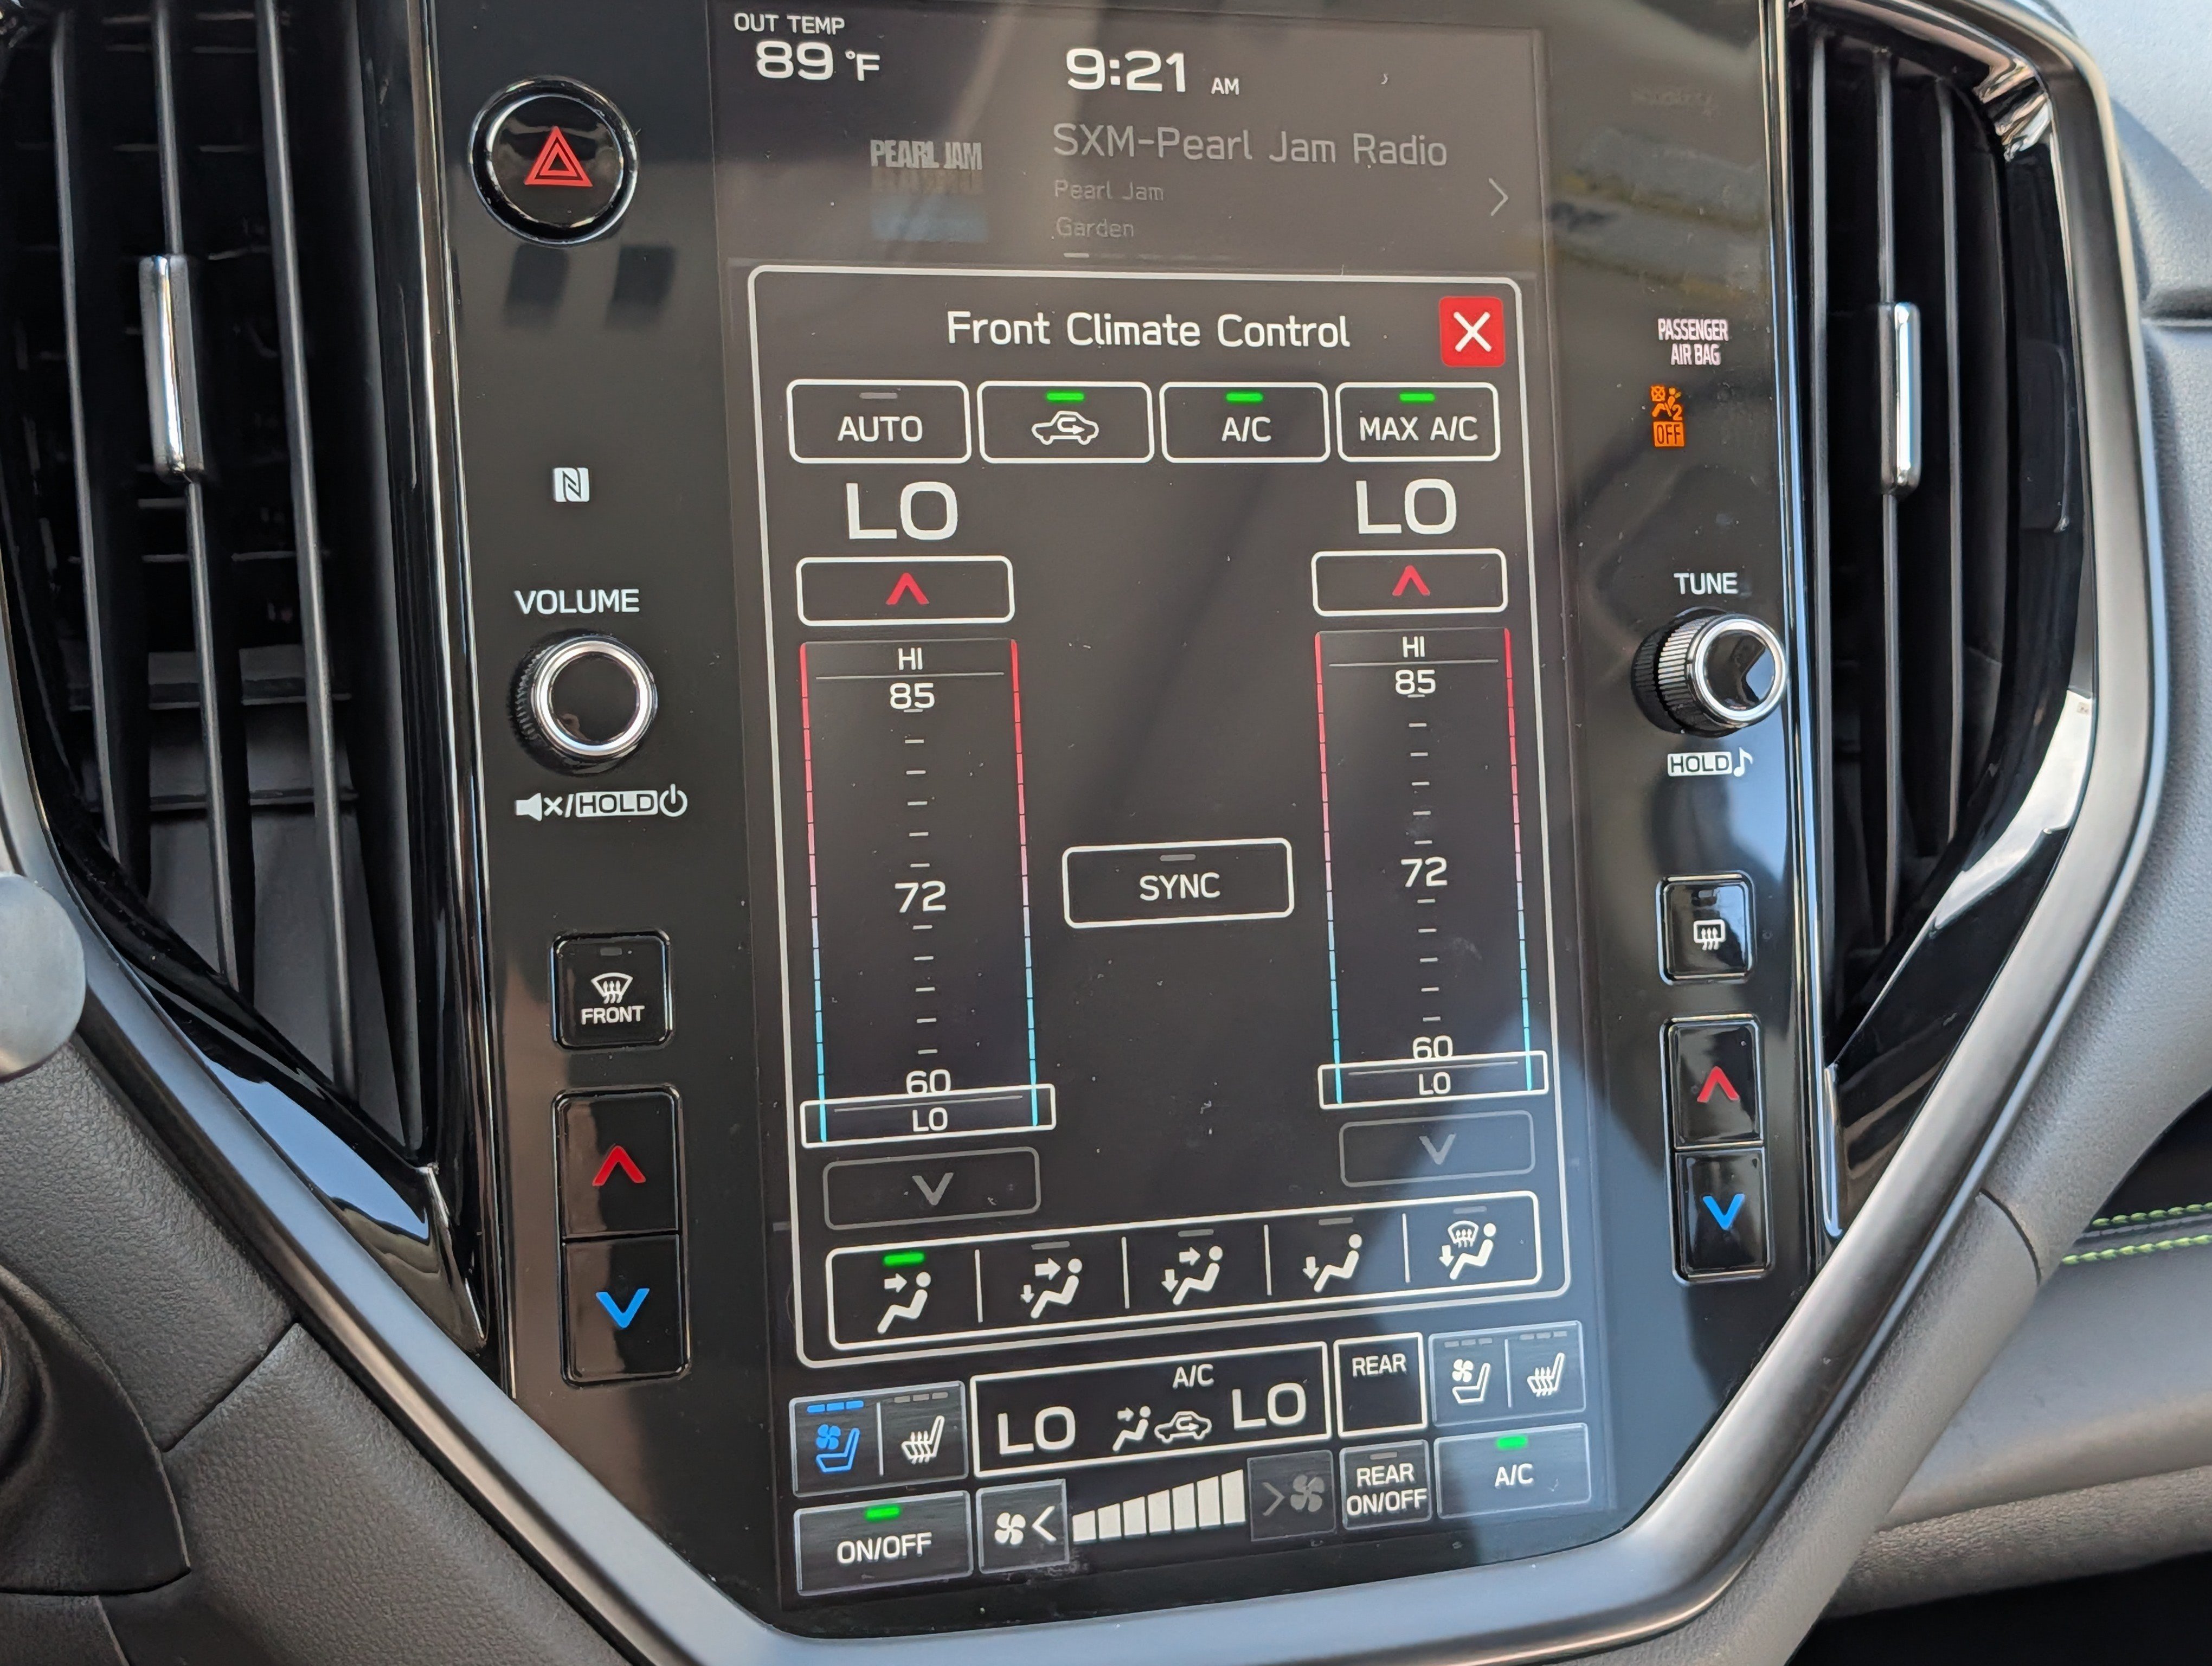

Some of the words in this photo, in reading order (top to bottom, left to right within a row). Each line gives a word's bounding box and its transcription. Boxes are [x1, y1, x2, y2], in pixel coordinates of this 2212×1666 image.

[734, 12, 779, 33] OUT
[787, 15, 845, 35] TEMP
[756, 41, 834, 80] 89
[1066, 48, 1186, 92] 9:21
[1211, 77, 1239, 95] AM
[870, 139, 940, 169] PEARL
[943, 142, 982, 170] JAM
[1053, 123, 1252, 161] SXM-Pearl
[1269, 130, 1336, 163] Jam
[1353, 132, 1448, 166] Radio
[1054, 180, 1113, 201] Pearl
[1122, 181, 1164, 202] Jam
[1056, 216, 1134, 238] Garden
[947, 311, 1051, 345] Front
[1066, 312, 1201, 347] Climate
[1217, 314, 1351, 348] Control
[1657, 318, 1728, 341] PASSENGER
[1671, 344, 1692, 364] AIR
[1694, 344, 1721, 366] BAG
[837, 415, 923, 442] AUTO
[1221, 417, 1271, 442] A/C
[1359, 416, 1419, 441] MAX
[1430, 416, 1478, 441] A/C
[1655, 424, 1682, 445] OFF
[845, 480, 958, 540] LO
[1356, 478, 1457, 535] LO
[1673, 572, 1738, 594] TUNE
[514, 588, 640, 614] VOLUME
[898, 648, 923, 670] HI
[1402, 636, 1426, 657] HI
[890, 682, 935, 709] 85
[1395, 670, 1436, 695] 85
[1670, 753, 1730, 773] HOLD
[1400, 857, 1448, 887] 72
[895, 880, 947, 913] 72
[1139, 872, 1221, 902] SYNC
[581, 1005, 645, 1025] FRONT
[1412, 1035, 1453, 1060] 60
[906, 1069, 951, 1095] 60
[1418, 1072, 1451, 1095] LO
[912, 1107, 948, 1132] LO
[1172, 1363, 1215, 1389] A/C
[1352, 1353, 1407, 1377] REAR
[1232, 1382, 1306, 1431] LO
[998, 1406, 1076, 1455] LO
[1356, 1463, 1414, 1488] REAR
[1495, 1463, 1534, 1489] A/C
[1346, 1488, 1427, 1516] ON/OFF
[837, 1532, 932, 1565] ON/OFF
